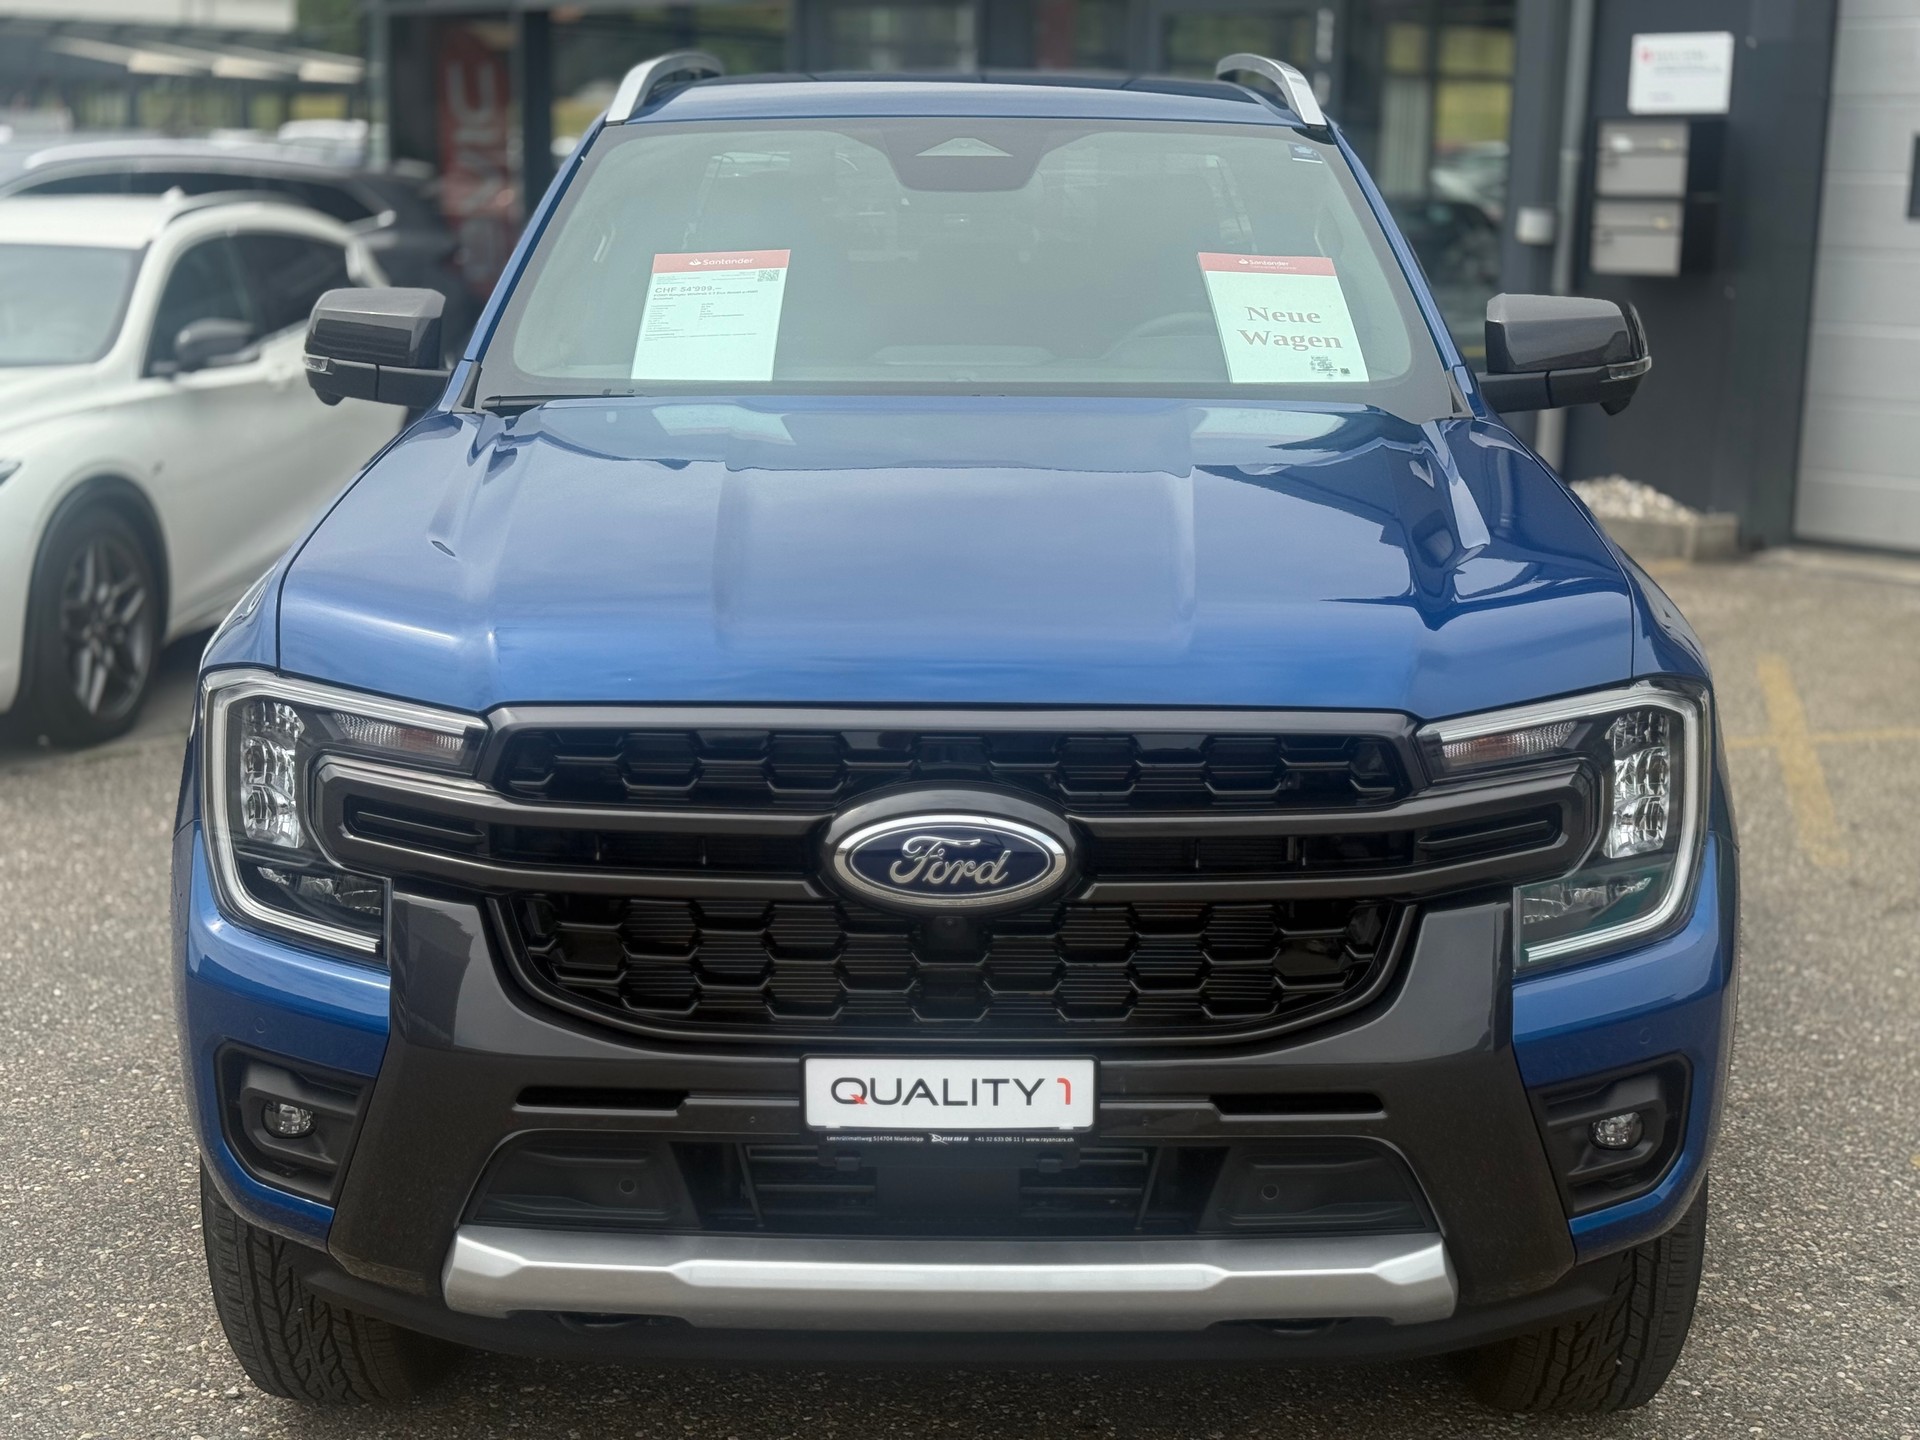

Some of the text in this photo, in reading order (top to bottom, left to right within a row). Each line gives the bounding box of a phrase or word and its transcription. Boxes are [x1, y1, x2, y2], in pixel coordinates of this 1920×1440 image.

[703, 258, 753, 266] Santander
[1244, 306, 1322, 324] Neue
[1236, 329, 1344, 352] Wagen
[889, 836, 1012, 885] Ford
[830, 1077, 1071, 1107] QUALITY 1
